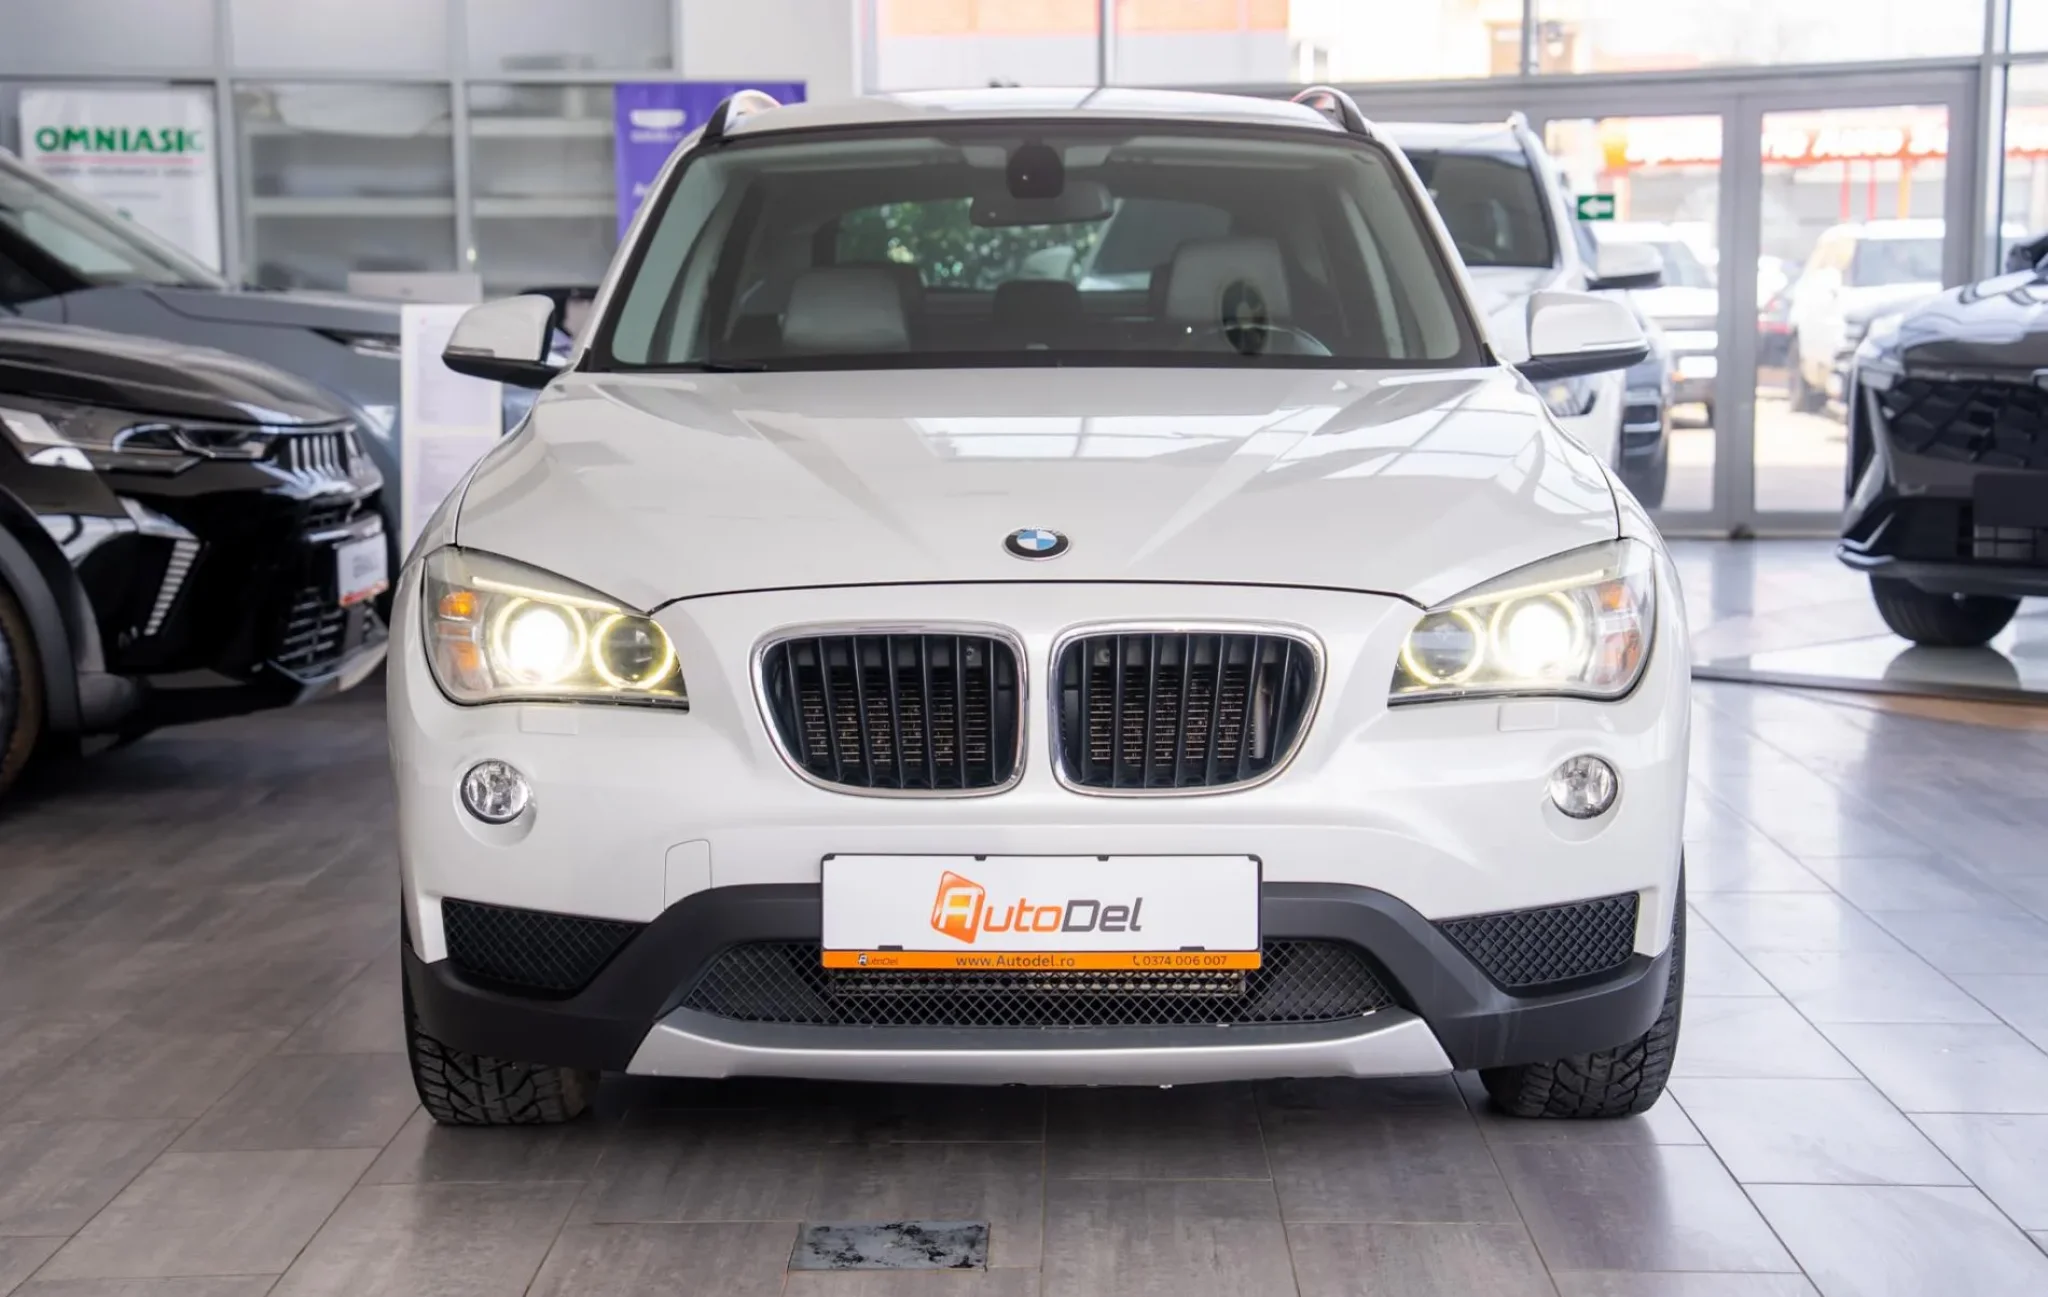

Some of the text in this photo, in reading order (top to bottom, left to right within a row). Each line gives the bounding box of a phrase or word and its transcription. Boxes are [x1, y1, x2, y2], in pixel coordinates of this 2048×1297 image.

[937, 886, 1143, 933] AutoDel
[956, 955, 1076, 967] www.Autodel.ro
[1142, 955, 1228, 966] 0374 006 007
